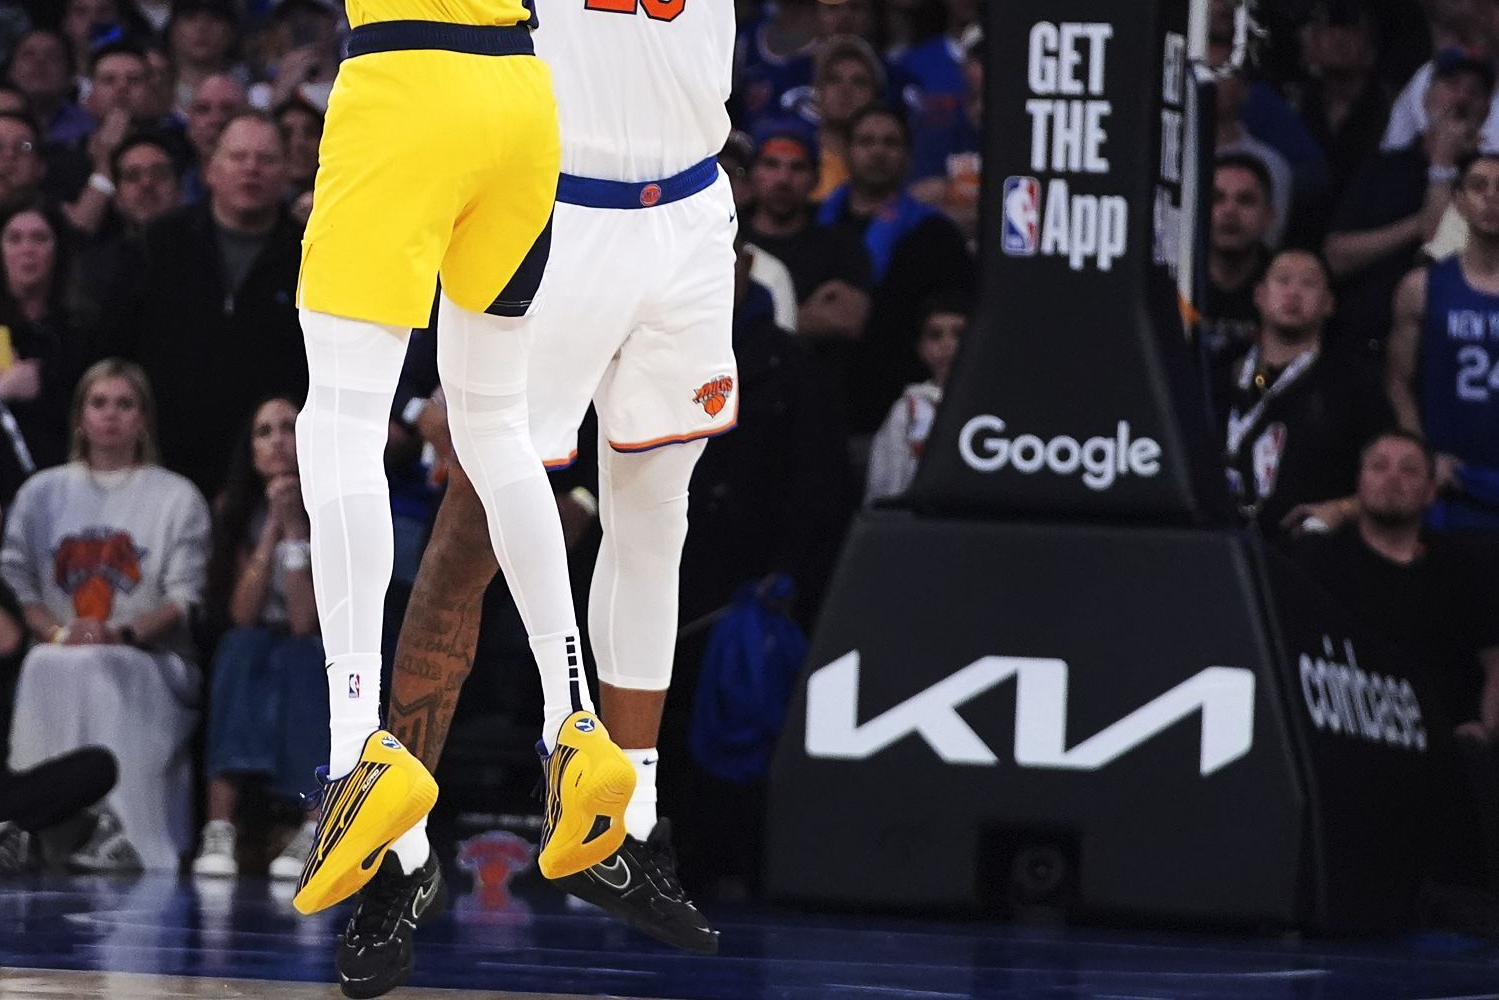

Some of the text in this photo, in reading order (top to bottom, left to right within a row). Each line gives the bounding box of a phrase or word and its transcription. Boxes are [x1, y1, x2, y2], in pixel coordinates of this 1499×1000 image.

[1027, 21, 1114, 96] GET
[1025, 99, 1112, 173] THE
[1041, 178, 1129, 271] App
[958, 414, 1161, 490] Google
[805, 649, 1255, 777] KIA
